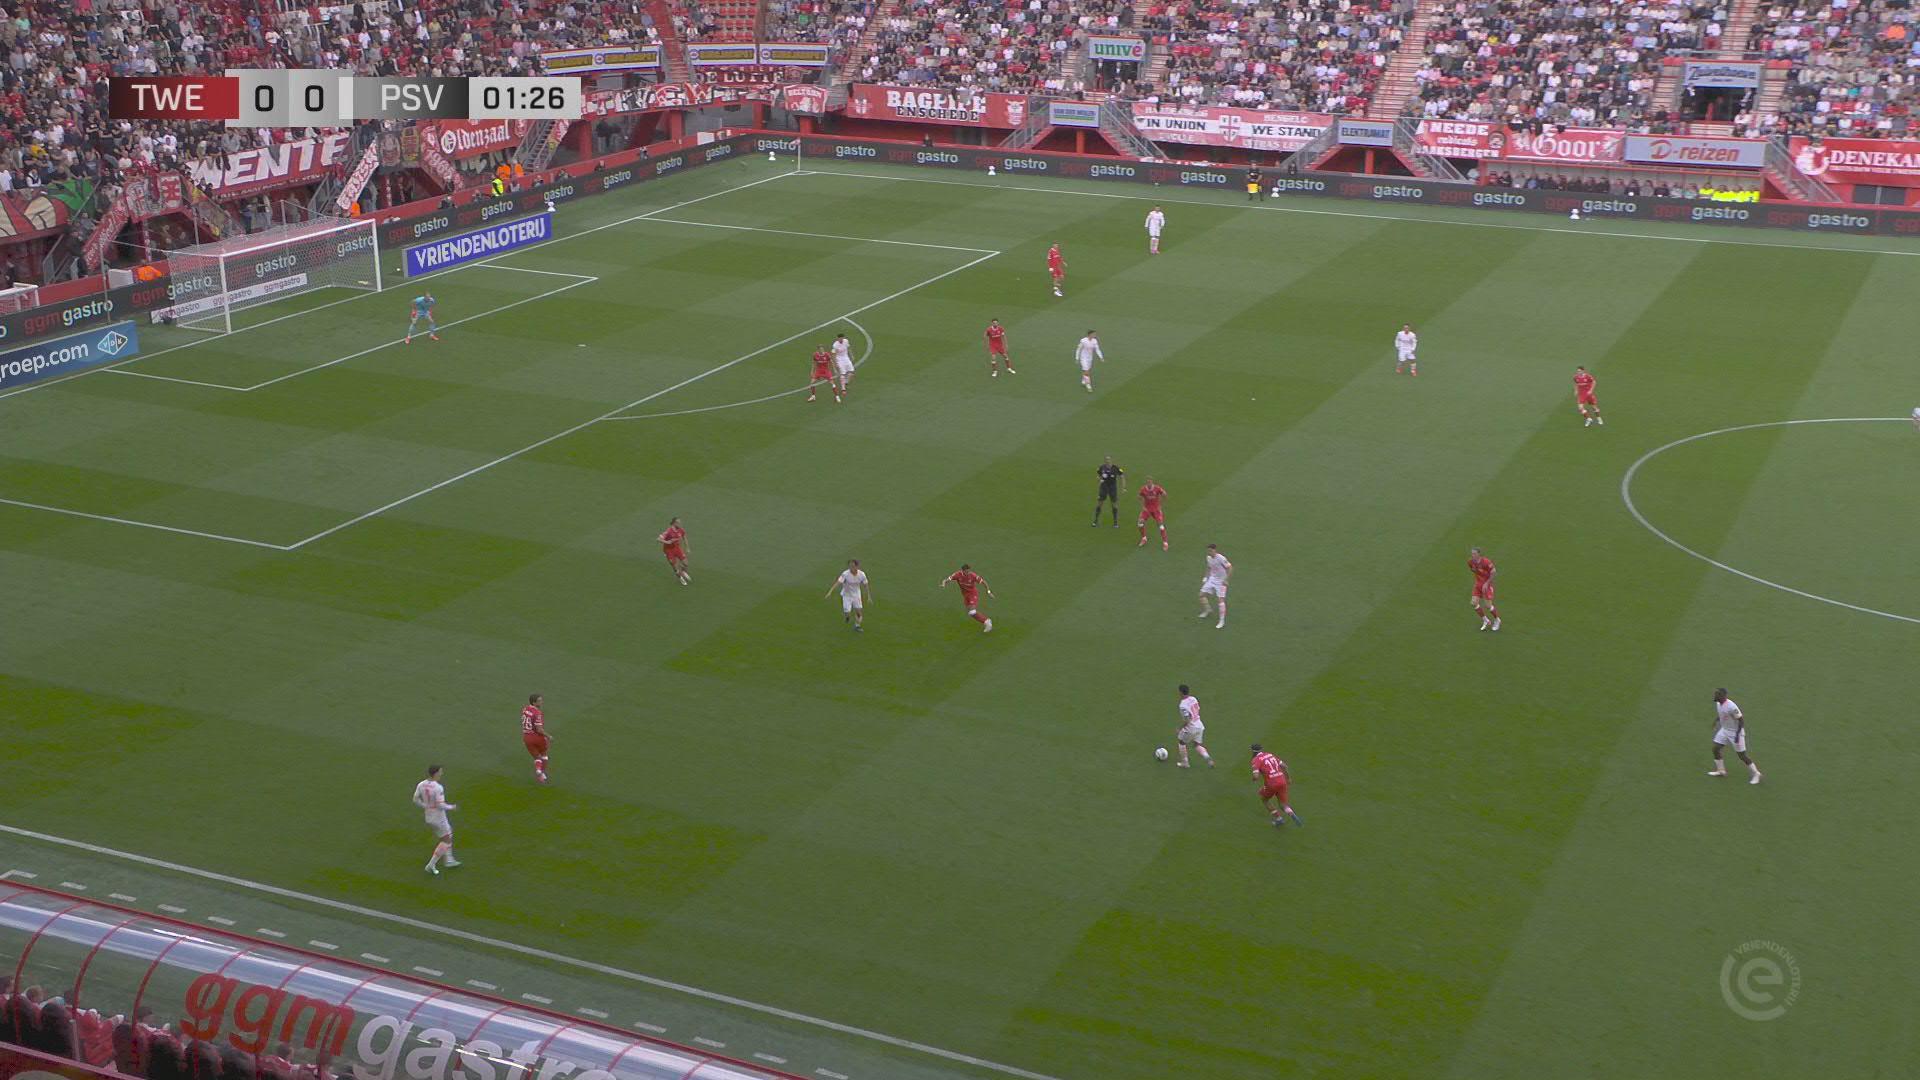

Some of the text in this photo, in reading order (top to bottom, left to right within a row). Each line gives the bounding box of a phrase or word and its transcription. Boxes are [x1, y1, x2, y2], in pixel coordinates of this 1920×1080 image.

[897, 105, 980, 122] ENSCHEDE
[440, 119, 511, 154] Oldenzaal
[1146, 118, 1160, 128] IN
[1165, 119, 1206, 131] UNION
[1251, 125, 1273, 136] WE
[1278, 126, 1321, 138] STAND
[1430, 121, 1489, 136] NEEDE
[758, 138, 797, 151] gastro
[836, 144, 876, 157] gastro
[656, 156, 683, 174] gastro
[917, 150, 959, 163] gastro
[1004, 157, 1047, 170] gastro
[603, 169, 631, 188] gastro
[1091, 164, 1135, 177] gastro
[1181, 170, 1227, 184] gastro
[1277, 177, 1325, 191] gastro
[1373, 183, 1423, 198] gastro
[543, 185, 574, 201] gastro
[1473, 191, 1525, 205] gastro
[481, 200, 514, 220] gastro
[1582, 198, 1637, 213] gastro
[1692, 205, 1749, 220] gastro
[414, 215, 449, 237] gastro
[1807, 211, 1869, 228] gastro
[337, 235, 375, 257] gastro
[415, 217, 546, 269] VRIENDENLOTERIJ
[255, 252, 297, 277] gastro
[167, 275, 213, 300] gastro
[62, 299, 114, 327] gastro
[0, 342, 89, 382] roep.com
